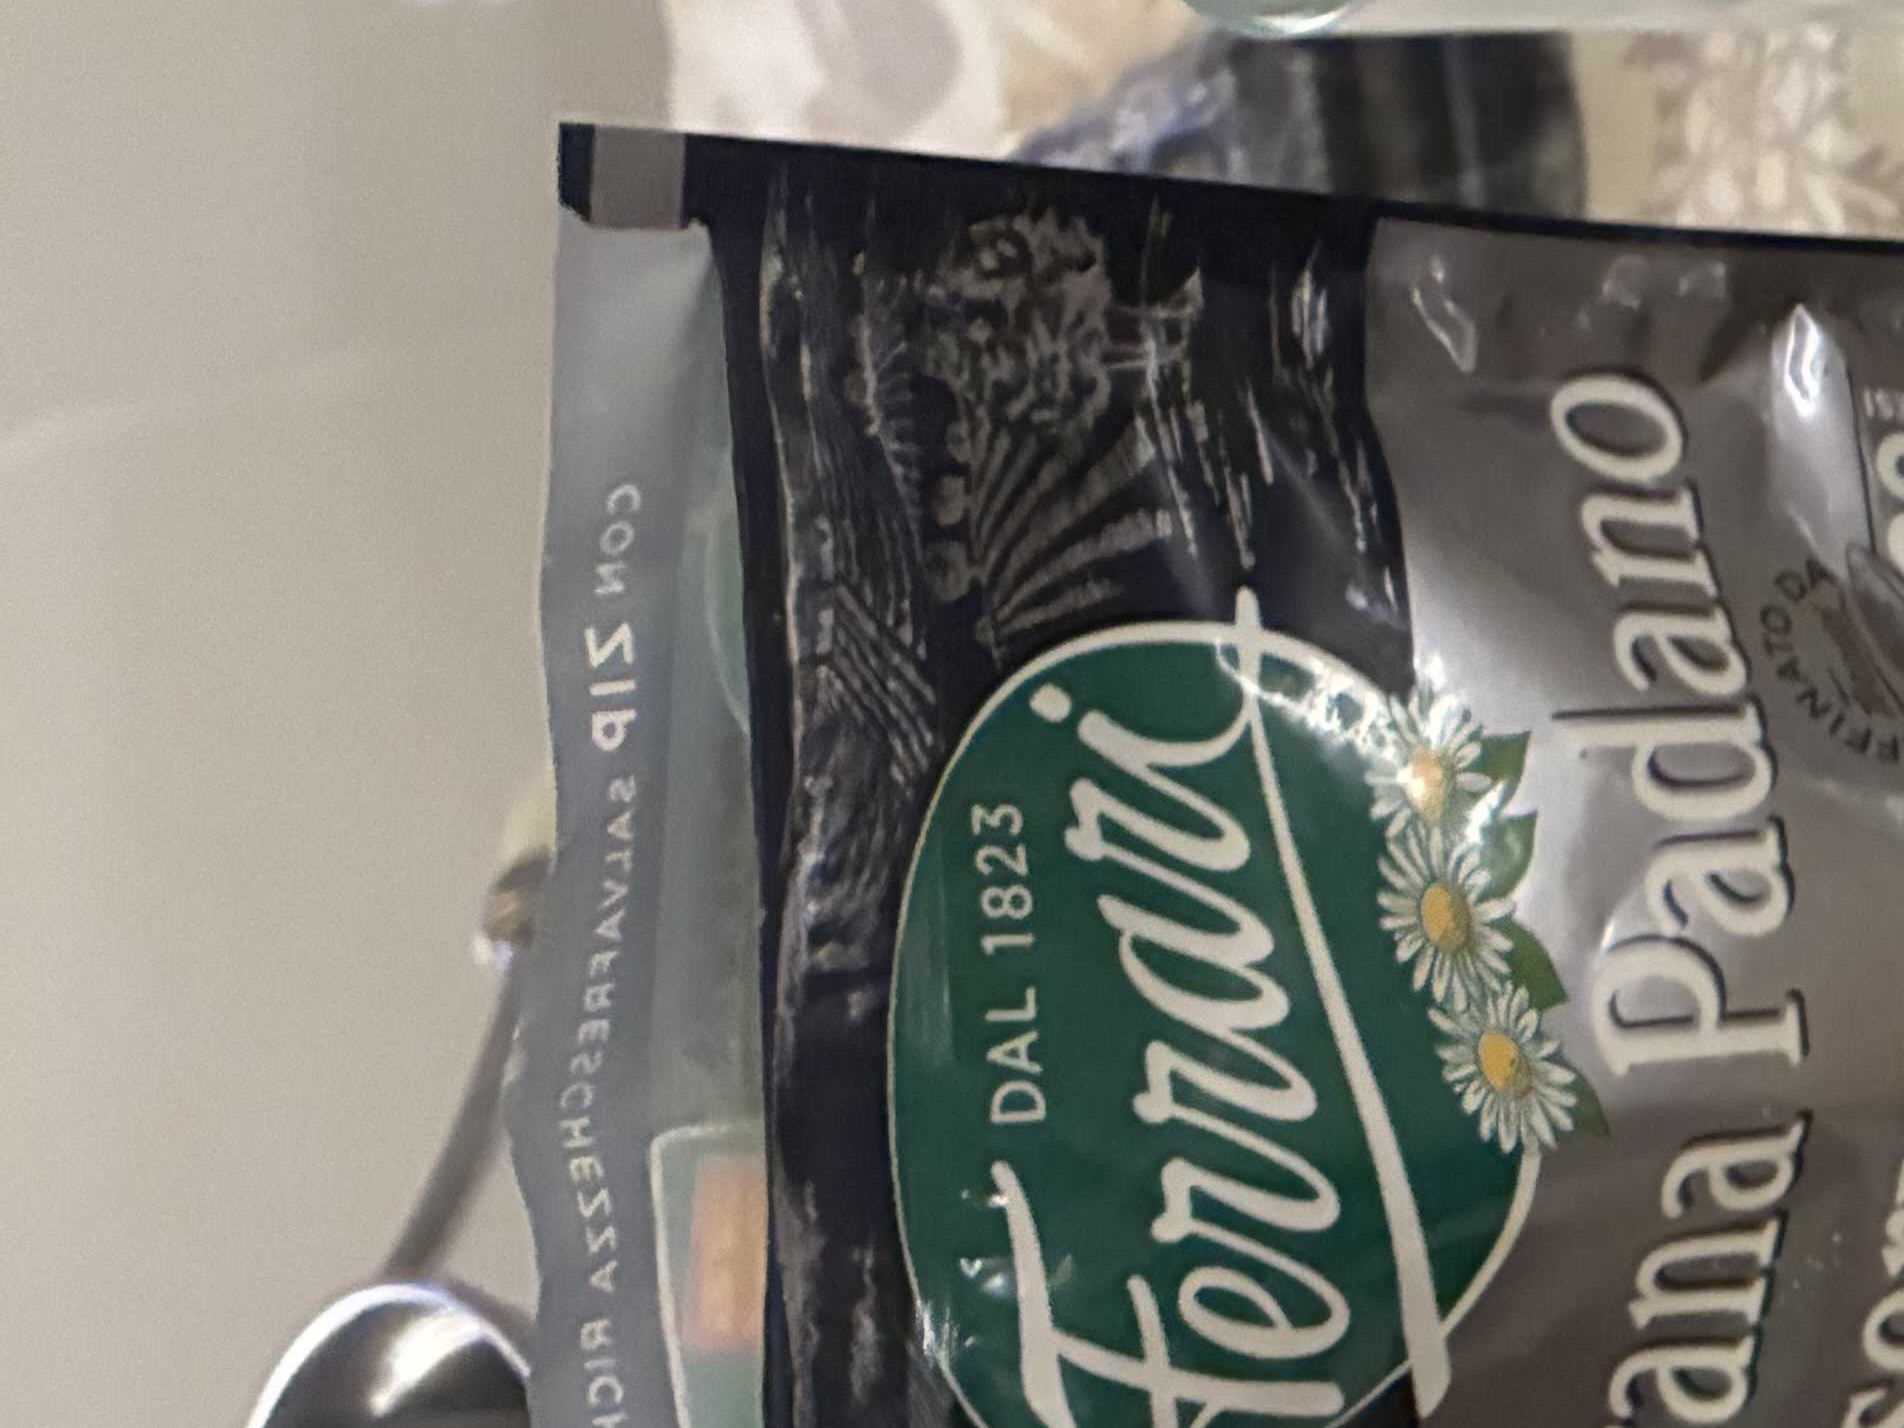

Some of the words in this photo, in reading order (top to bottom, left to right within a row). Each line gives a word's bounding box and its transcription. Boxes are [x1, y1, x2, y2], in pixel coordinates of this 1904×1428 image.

[1774, 557, 1837, 603] DA
[1546, 372, 1805, 1076] Padano
[970, 801, 1034, 956] 1823
[988, 986, 1048, 1123] DAL
